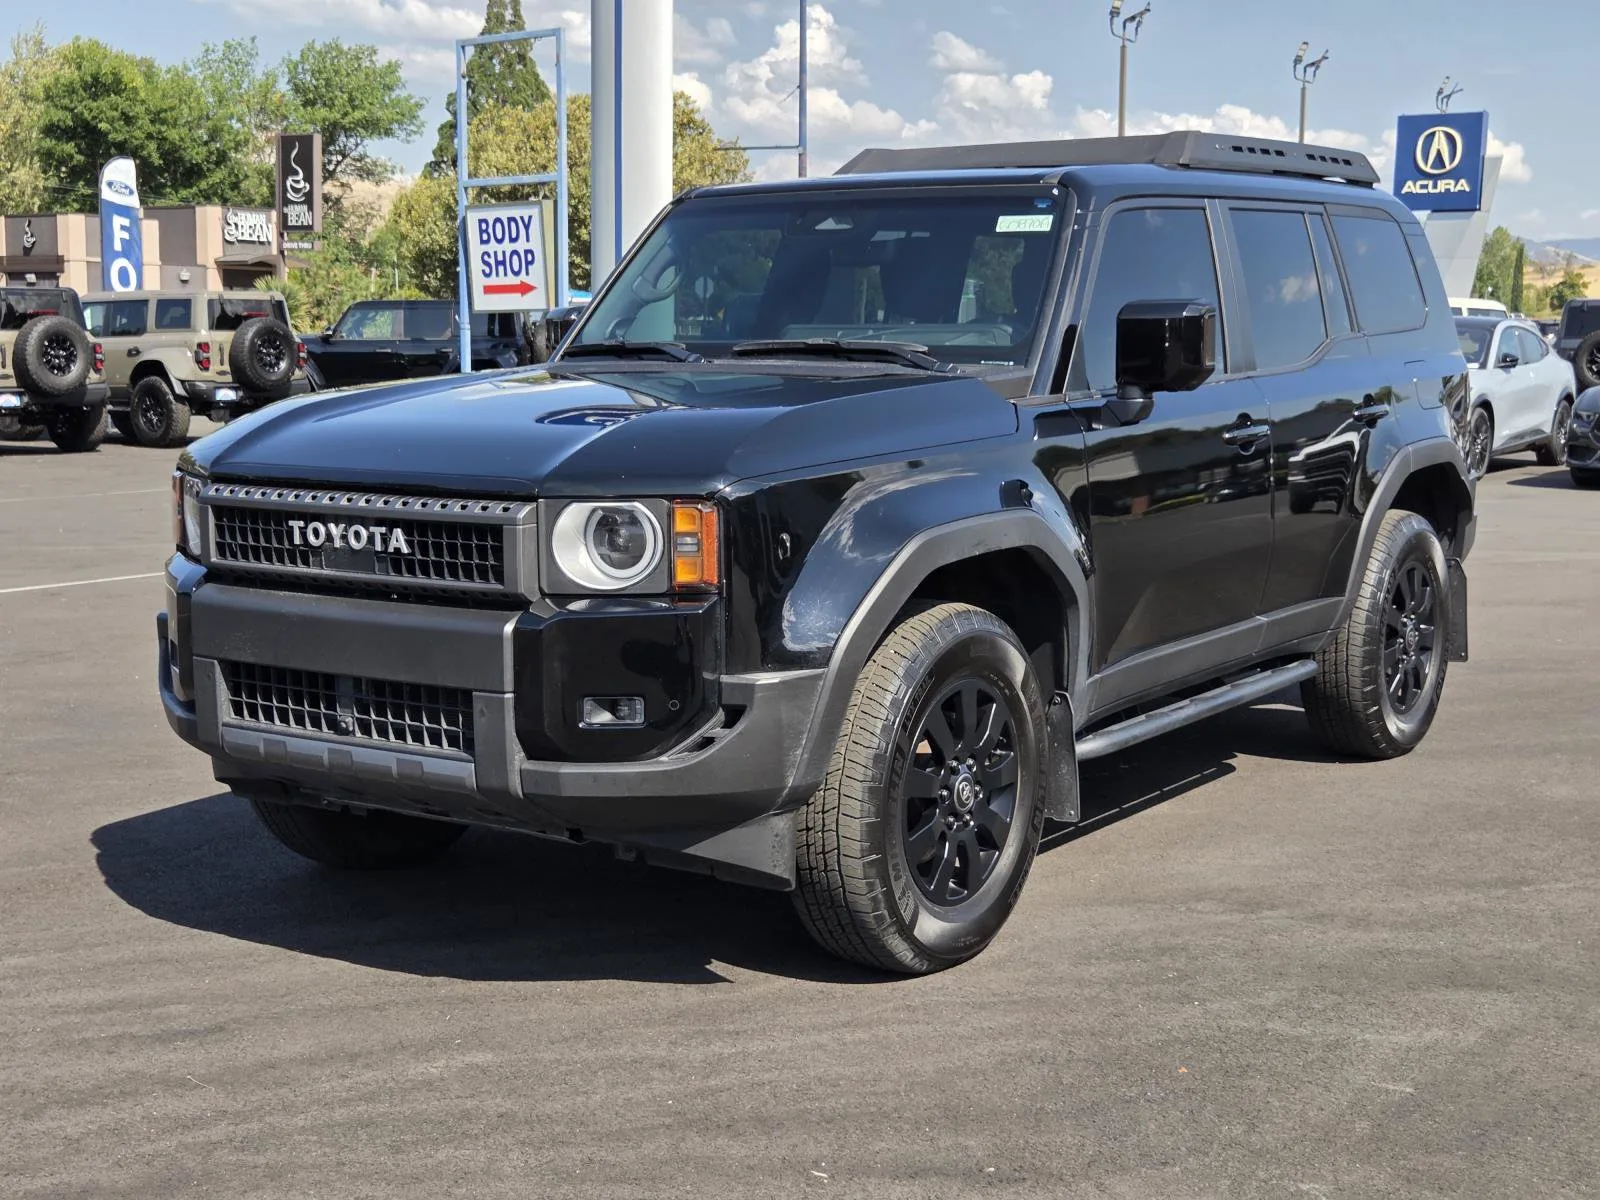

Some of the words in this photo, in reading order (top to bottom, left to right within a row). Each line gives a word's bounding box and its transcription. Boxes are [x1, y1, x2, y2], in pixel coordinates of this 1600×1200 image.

[1401, 179, 1470, 194] ACURA
[288, 210, 312, 226] BEAN
[478, 215, 533, 245] BODY
[238, 223, 272, 242] BEAN
[480, 249, 536, 278] SHOP
[288, 520, 412, 554] TOYOTA
